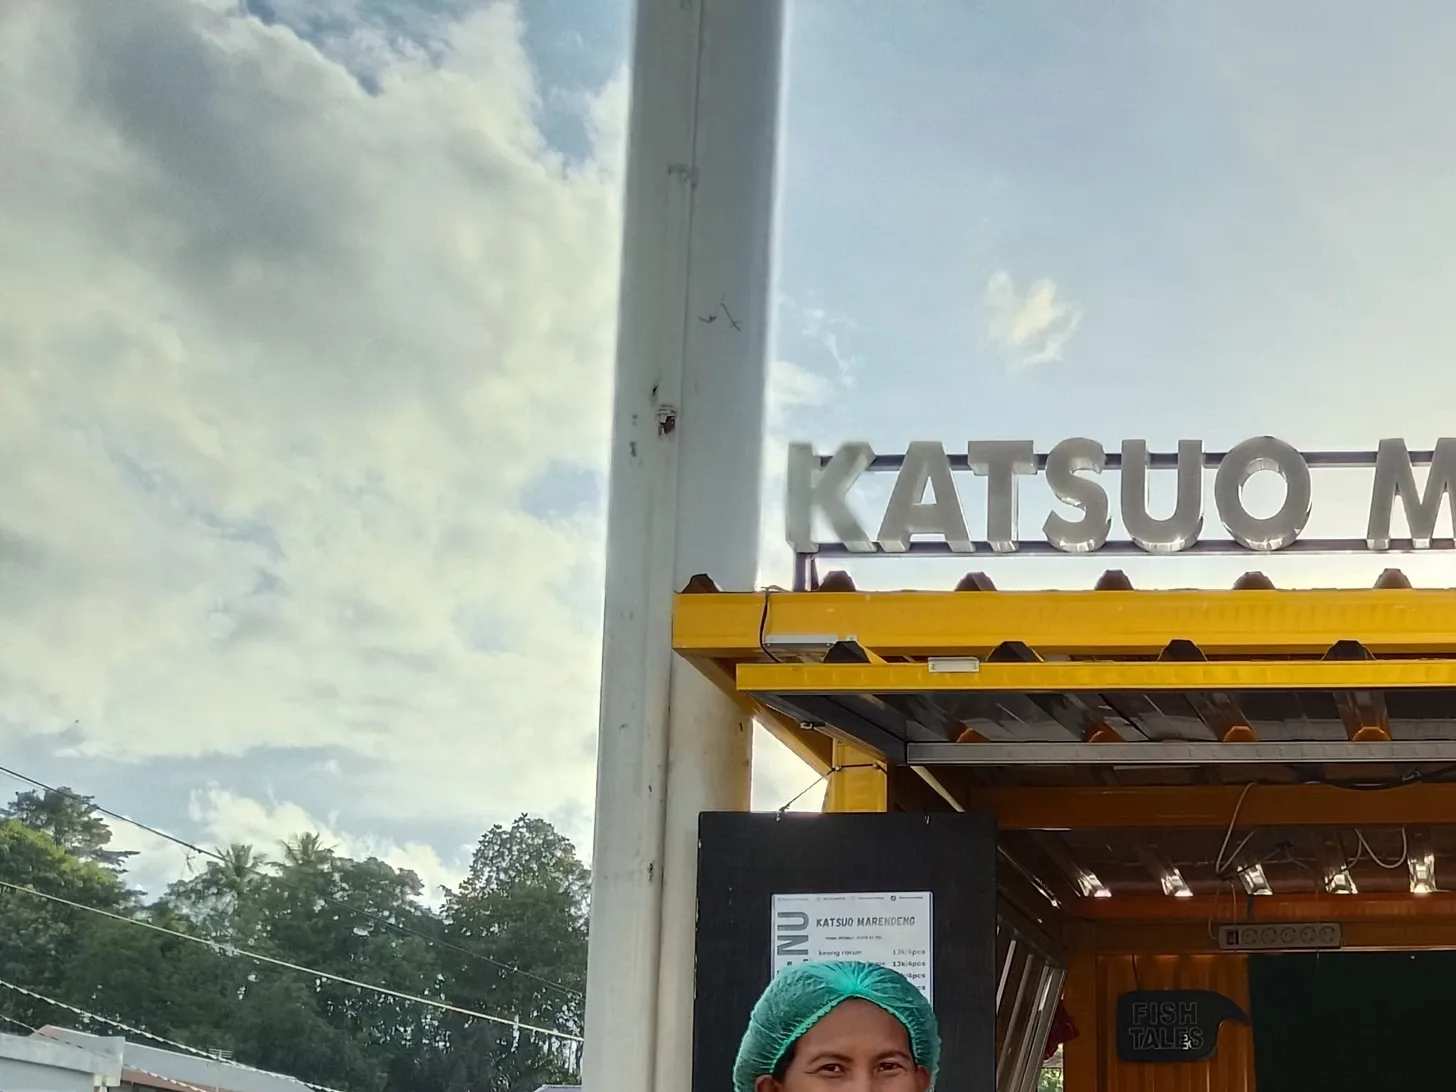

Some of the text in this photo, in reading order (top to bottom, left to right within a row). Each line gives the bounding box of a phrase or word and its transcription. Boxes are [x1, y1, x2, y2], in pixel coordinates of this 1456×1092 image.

[786, 436, 1312, 554] KATSUO
[816, 917, 854, 927] KATSUO
[1132, 1002, 1198, 1025] FISH
[1128, 1027, 1204, 1050] TALES
